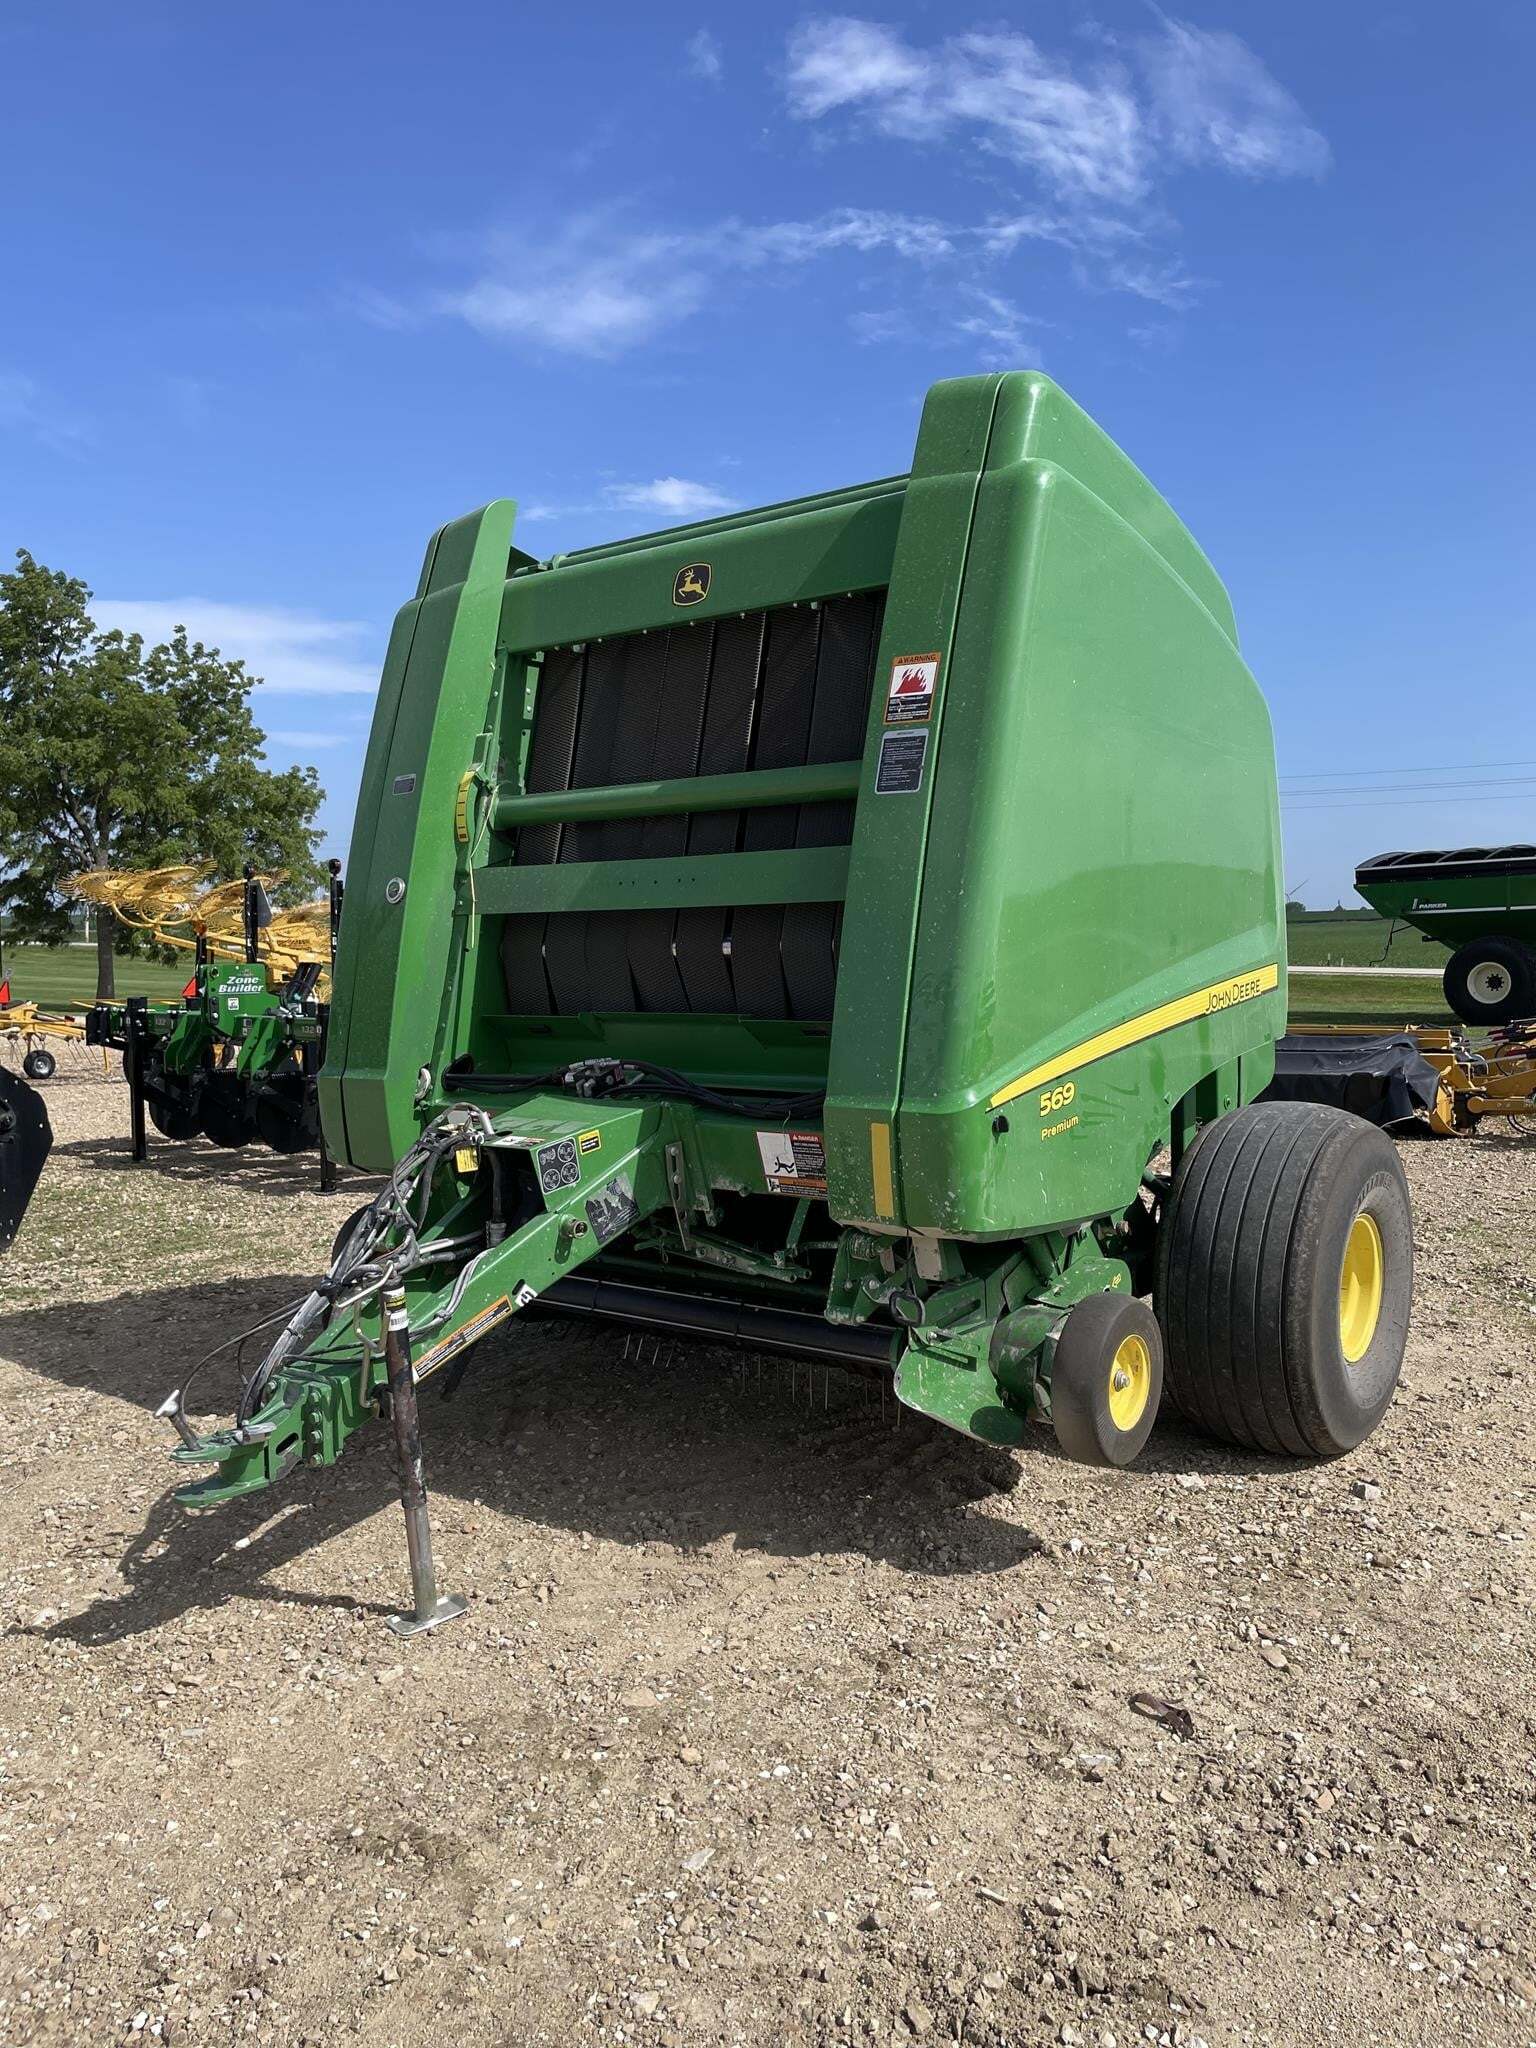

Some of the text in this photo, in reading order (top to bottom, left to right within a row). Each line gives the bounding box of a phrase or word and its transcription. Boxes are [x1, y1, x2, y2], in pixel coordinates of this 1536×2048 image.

[218, 983, 264, 993] Builder
[226, 976, 259, 985] Zone
[1039, 1081, 1075, 1117] 569
[1041, 1115, 1079, 1142] Premium
